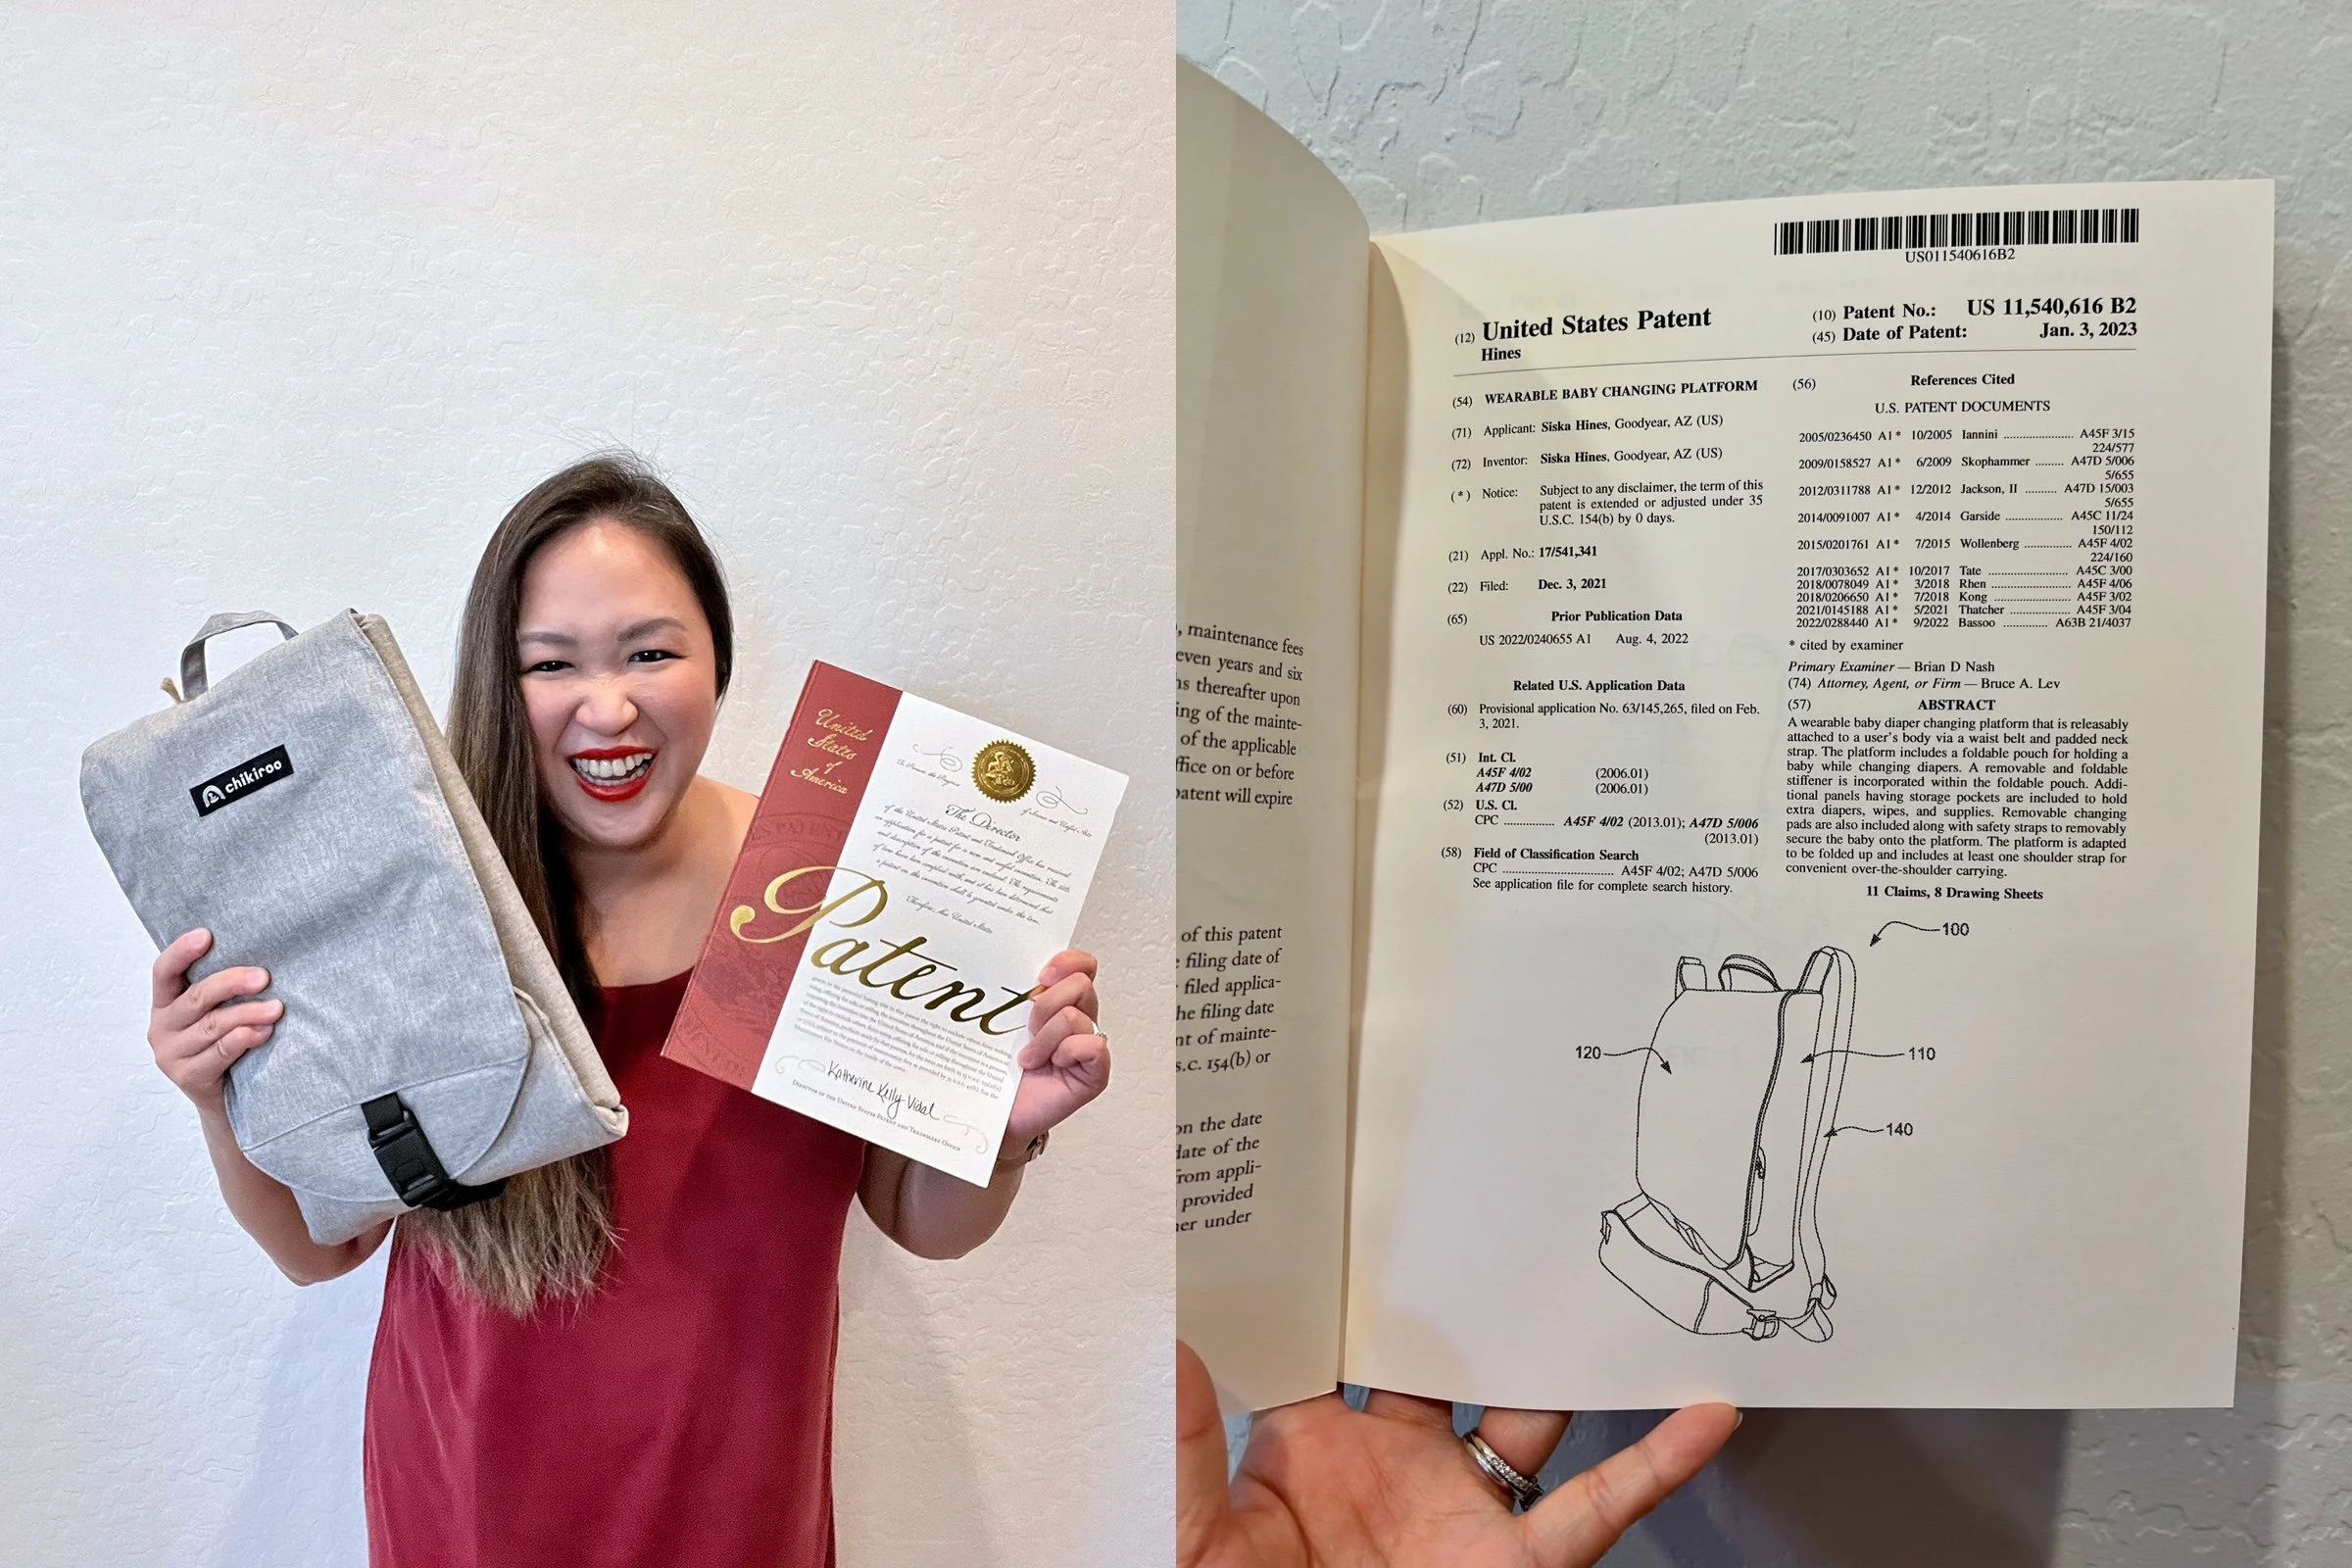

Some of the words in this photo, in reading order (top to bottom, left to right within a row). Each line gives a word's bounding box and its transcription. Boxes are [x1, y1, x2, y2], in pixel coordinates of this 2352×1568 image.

[1904, 247, 2015, 263] US011540616B2
[1812, 309, 1836, 322] (10)
[1843, 305, 1895, 319] Patent
[1902, 303, 1936, 318] No.:
[1967, 298, 1994, 316] US
[2003, 297, 2103, 318] 11,540,616
[2110, 296, 2136, 314] B2
[1454, 332, 1475, 345] (12)
[1482, 317, 1552, 341] United
[1561, 314, 1628, 334] States
[1637, 308, 1711, 329] Patent
[1812, 330, 1836, 344] (45)
[1842, 326, 1880, 341] Date
[1886, 324, 1904, 339] of
[1908, 324, 1967, 339] Patent:
[2039, 322, 2074, 338] Jan.
[2079, 321, 2093, 339] 3,
[2098, 321, 2137, 336] 2023
[1481, 347, 1521, 361] Hines
[1792, 378, 1816, 391] (56)
[1910, 374, 1977, 386] References
[1982, 373, 2015, 384] Cited
[1452, 395, 1472, 409] (54)
[1485, 389, 1557, 404] WEARABLE
[1562, 387, 1597, 399] BABY
[1601, 383, 1676, 397] CHANGING
[1681, 379, 1757, 393] PLATFORM
[1875, 402, 1899, 414] U.S.
[1904, 401, 1957, 413] PATENT
[1961, 400, 2050, 412] DOCUMENTS
[1451, 426, 1471, 440] (71)
[1483, 423, 1536, 438] Applicant:
[1541, 420, 1571, 432] Siska
[1575, 419, 1610, 430] Hines,
[1614, 416, 1670, 430] Goodyear,
[1674, 415, 1692, 426] AZ
[1696, 414, 1723, 427] (US)
[1798, 430, 1872, 442] 2005/0236450
[1912, 429, 1952, 440] 10/2005
[1962, 428, 1997, 439] Iannini
[2080, 428, 2109, 438] A45F
[2112, 428, 2134, 438] 3/15
[1482, 487, 1518, 499] Notice:
[1540, 484, 1579, 498] Subject
[1582, 485, 1592, 494] to
[1594, 485, 1614, 496] any
[1617, 481, 1677, 493] disclaimer,
[1680, 480, 1696, 492] the
[1699, 481, 1725, 491] term
[1728, 479, 1741, 490] of
[1742, 478, 1763, 490] this
[1448, 550, 1469, 563] (21)
[1480, 548, 1507, 562] Appl.
[1512, 547, 1534, 558] No.:
[1540, 545, 1596, 559] 17/541,341
[1447, 581, 1468, 594] (22)
[1480, 580, 1508, 591] Filed:
[1538, 578, 1562, 589] Dec.
[1565, 578, 1576, 591] 3,
[1580, 577, 1606, 589] 2021
[1446, 613, 1467, 626] (65)
[1551, 611, 1581, 621] Prior
[1585, 610, 1650, 621] Publication
[1654, 610, 1682, 620] Data
[1795, 617, 1869, 627] 2022/0288440
[1913, 617, 1948, 627] 9/2022
[1958, 617, 1995, 627] Bassoo
[2055, 617, 2085, 627] A63B
[2088, 616, 2132, 627] 21/4037
[1187, 624, 1278, 651] maintenance
[1281, 637, 1303, 656] fees
[1479, 634, 1494, 646] US
[1498, 633, 1572, 645] 2022/0240655
[1615, 633, 1642, 647] Aug.
[1645, 633, 1656, 645] 4,
[1661, 632, 1689, 644] 2022
[1216, 657, 1253, 673] years
[1258, 662, 1283, 677] and
[1287, 665, 1302, 681] six
[1788, 661, 1835, 674] Primary
[1839, 661, 1895, 672] Examiner
[1914, 661, 1945, 671] Brian
[1950, 661, 1961, 671] D
[1965, 661, 1994, 671] Nash
[1197, 677, 1266, 701] thereafter
[1270, 692, 1299, 709] upon
[1513, 679, 1554, 691] Related
[1558, 679, 1582, 690] U.S.
[1585, 679, 1652, 693] Application
[1657, 679, 1685, 691] Data
[1788, 698, 1811, 711] (57)
[1918, 699, 1996, 710] ABSTRACT
[815, 709, 874, 742] United
[1205, 707, 1225, 721] of
[1227, 709, 1250, 724] the
[1253, 713, 1301, 730] mainte-
[1788, 716, 1797, 727] A
[1800, 716, 1850, 727] wearable
[1853, 716, 1881, 730] baby
[1884, 716, 1921, 730] diaper
[1923, 717, 1976, 731] changing
[1980, 717, 2029, 731] platform
[2033, 717, 2054, 729] that
[2057, 717, 2067, 729] is
[2070, 717, 2129, 732] releasably
[807, 736, 858, 760] States
[1180, 731, 1200, 746] of
[1202, 733, 1226, 749] the
[1231, 737, 1297, 756] applicable
[224, 760, 282, 793] chikiroo
[790, 767, 849, 795] America
[1224, 788, 1250, 803] will
[1254, 790, 1293, 809] expire
[946, 804, 975, 821] The
[969, 812, 1021, 843] Director
[1441, 846, 1461, 859] (58)
[1473, 847, 1500, 858] Field
[1504, 848, 1517, 858] of
[1520, 848, 1594, 859] Classification
[1598, 849, 1639, 860] Search
[1867, 885, 1878, 896] 11
[1884, 885, 1930, 899] Claims,
[1934, 886, 1941, 897] 8
[1946, 887, 1999, 901] Drawing
[2003, 887, 2043, 900] Sheets
[1181, 927, 1201, 942] of
[1204, 926, 1233, 942] this
[1238, 926, 1282, 944] patent
[1942, 922, 1969, 936] 100
[729, 864, 1045, 1036] Patent
[1185, 952, 1228, 970] filing
[1231, 950, 1262, 966] date
[1265, 947, 1283, 963] of
[1575, 1045, 1601, 1059] 120
[1908, 1046, 1936, 1060] 110
[827, 1060, 875, 1093] Katherine
[876, 1082, 907, 1119] Kelly
[907, 1094, 940, 1121] Vidal
[1886, 1122, 1913, 1136] 140
[1181, 1184, 1253, 1212] provided
